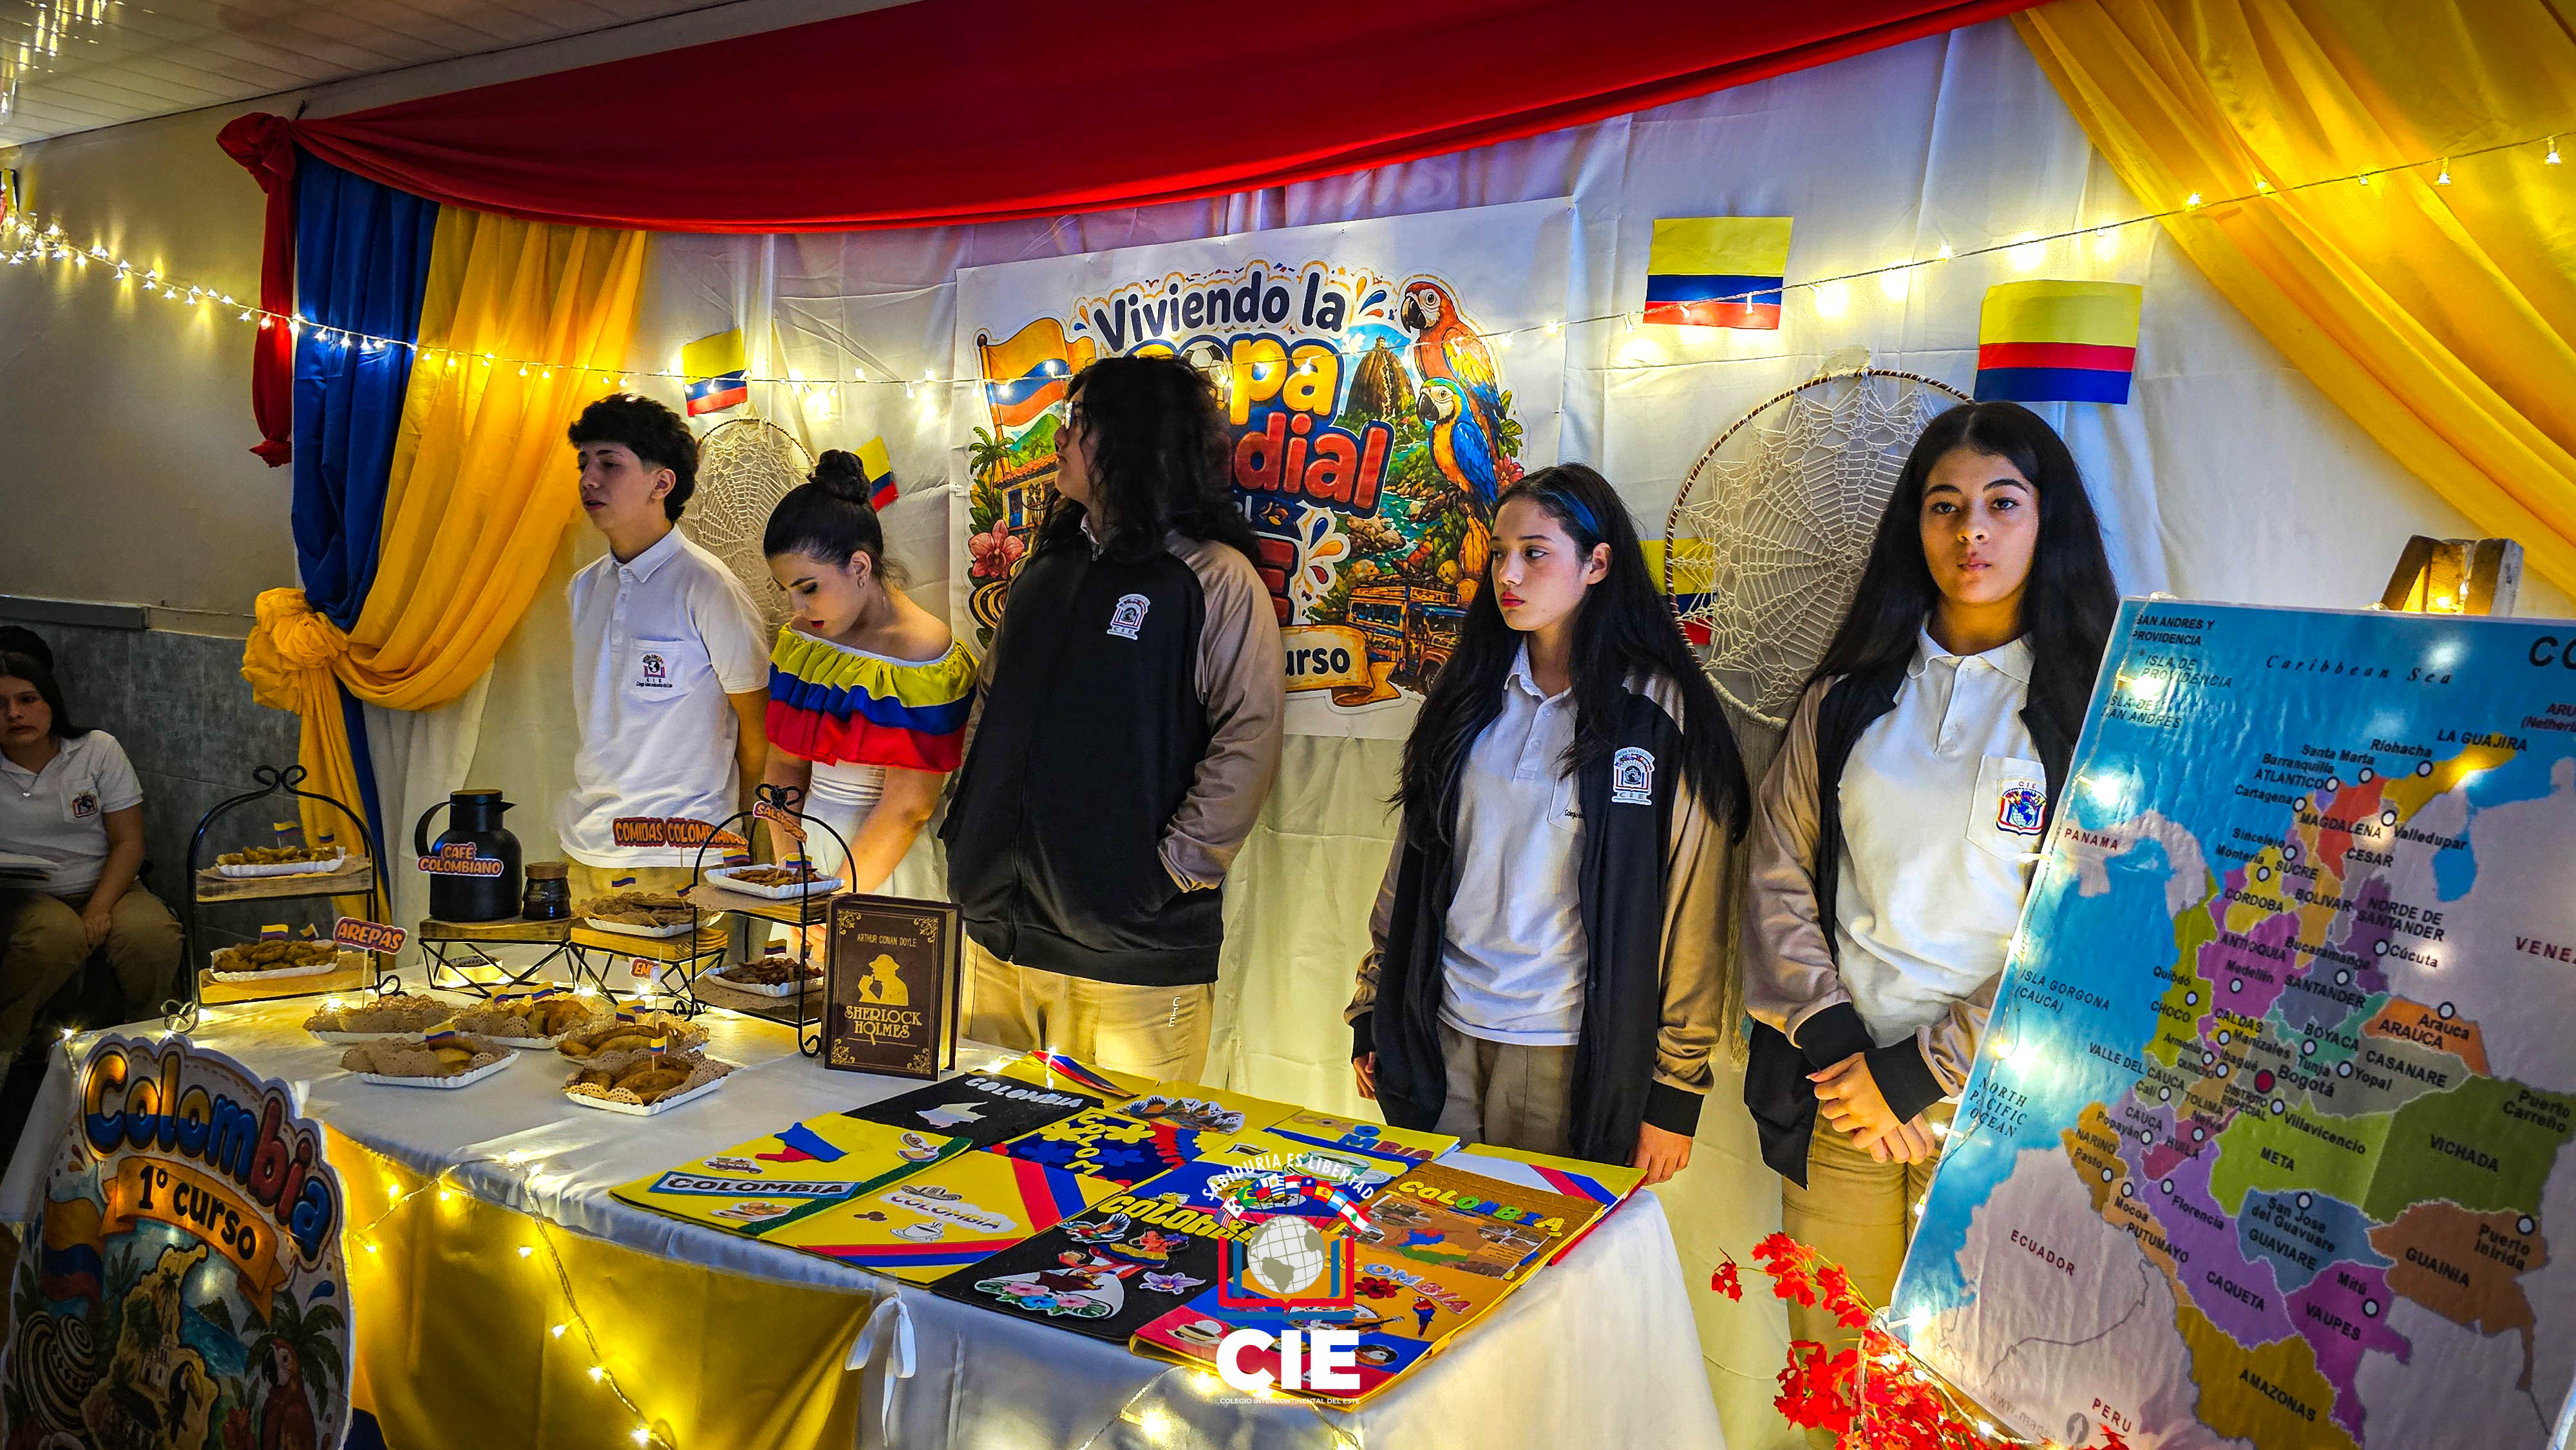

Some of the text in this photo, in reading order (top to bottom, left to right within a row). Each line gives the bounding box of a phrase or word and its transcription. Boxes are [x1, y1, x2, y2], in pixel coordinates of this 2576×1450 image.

[1094, 270, 1345, 352] Viviendo la
[1224, 412, 1388, 509] dial
[2159, 617, 2203, 630] ANDRES
[2206, 619, 2215, 630] Y
[2145, 655, 2197, 671] ISLA DE
[2266, 655, 2452, 684] Caribbean Sea
[2141, 668, 2232, 688] PROVIDENCIA
[2136, 699, 2154, 711] DE
[2128, 711, 2182, 729] ANDRES
[2301, 744, 2336, 760] Santa
[2370, 739, 2432, 758] Riohacha
[2437, 729, 2527, 751] LA GUAJIRA
[2262, 753, 2335, 775] Barranquilla
[2254, 769, 2324, 789] ATLANTICO
[2235, 784, 2293, 805] Cartagena
[616, 822, 663, 842] COMIDAS
[2232, 827, 2286, 849] Sincelejo
[2299, 813, 2381, 838] MAGDALENA
[2394, 825, 2467, 851] Valledupar
[444, 844, 474, 859] CAFÉ
[2065, 828, 2118, 851] PANAMA
[420, 858, 501, 874] COLOMBIANO
[2275, 860, 2319, 880] SUCRE
[2346, 847, 2394, 868] CESAR
[2224, 889, 2284, 913] CORDOBA
[2295, 888, 2352, 912] BOLIVAR
[2356, 909, 2445, 942] SANTANDER
[2421, 910, 2443, 926] DE
[337, 923, 402, 949] AREPAS
[857, 933, 916, 947] ARTHUR CONAN DOYLE
[2221, 933, 2286, 963] ANTIOQUIA
[2286, 936, 2371, 970] Bucaramanga
[2390, 945, 2438, 968] Cúcuta
[2014, 985, 2063, 1014] (CAUCA)
[2021, 969, 2109, 1012] ISLA GORGONA
[2285, 974, 2366, 1009] SANTANDER
[844, 1006, 922, 1026] SHERLOCK
[2150, 1001, 2192, 1023] CHOCO
[2215, 1008, 2264, 1033] CALDAS
[855, 1020, 911, 1040] HOLMES
[2304, 1022, 2359, 1051] BOYACA
[2378, 1019, 2443, 1050] ARAUCA
[2418, 1013, 2470, 1040] Arauca
[2163, 1032, 2202, 1054] Armenia
[2234, 1028, 2291, 1059] Manizales
[2089, 1042, 2185, 1091] VALLE DEL CAUCA
[2298, 1054, 2331, 1078] Tunja
[2350, 1067, 2393, 1091] Yopal
[2365, 1050, 2448, 1089] CASANARE
[965, 1077, 1083, 1107] COLOMBIA
[1978, 1076, 2028, 1107] NORTH
[2136, 1080, 2156, 1097] Cali
[2277, 1064, 2334, 1098] Bogotá
[2184, 1092, 2223, 1117] TOLIMA
[2519, 1088, 2571, 1118] Puerto
[1969, 1107, 2017, 1138] OCEAN
[2097, 1111, 2140, 1140] Popayán
[2125, 1106, 2163, 1132] CAUCA
[2284, 1111, 2366, 1155] Villavicencio
[84, 1051, 332, 1262] Colombia
[2074, 1149, 2102, 1169] Pasto
[2164, 1135, 2199, 1160] HUILA
[2260, 1146, 2295, 1172] META
[2430, 1133, 2499, 1173] VICHADA
[667, 1177, 843, 1193] COLOMBIA
[891, 1194, 1002, 1229] COLOMBIA
[1398, 1181, 1565, 1232] COLOMBIA
[2114, 1195, 2149, 1223] Mocoa
[2171, 1195, 2225, 1231] Florencia
[2251, 1205, 2270, 1222] del
[2268, 1197, 2291, 1218] San
[172, 1187, 257, 1260] curso
[2126, 1222, 2189, 1263] PUTUMAYO
[2249, 1227, 2317, 1272] GUAVIARE
[2479, 1223, 2531, 1256] Puerto
[2010, 1229, 2076, 1277] ECUADOR
[2405, 1247, 2470, 1288] GUAINIA
[2206, 1270, 2265, 1312] CAQUETA
[2306, 1301, 2362, 1342] VAUPES
[2239, 1368, 2317, 1422] AMAZONAS
[2092, 1397, 2132, 1433] PERU
